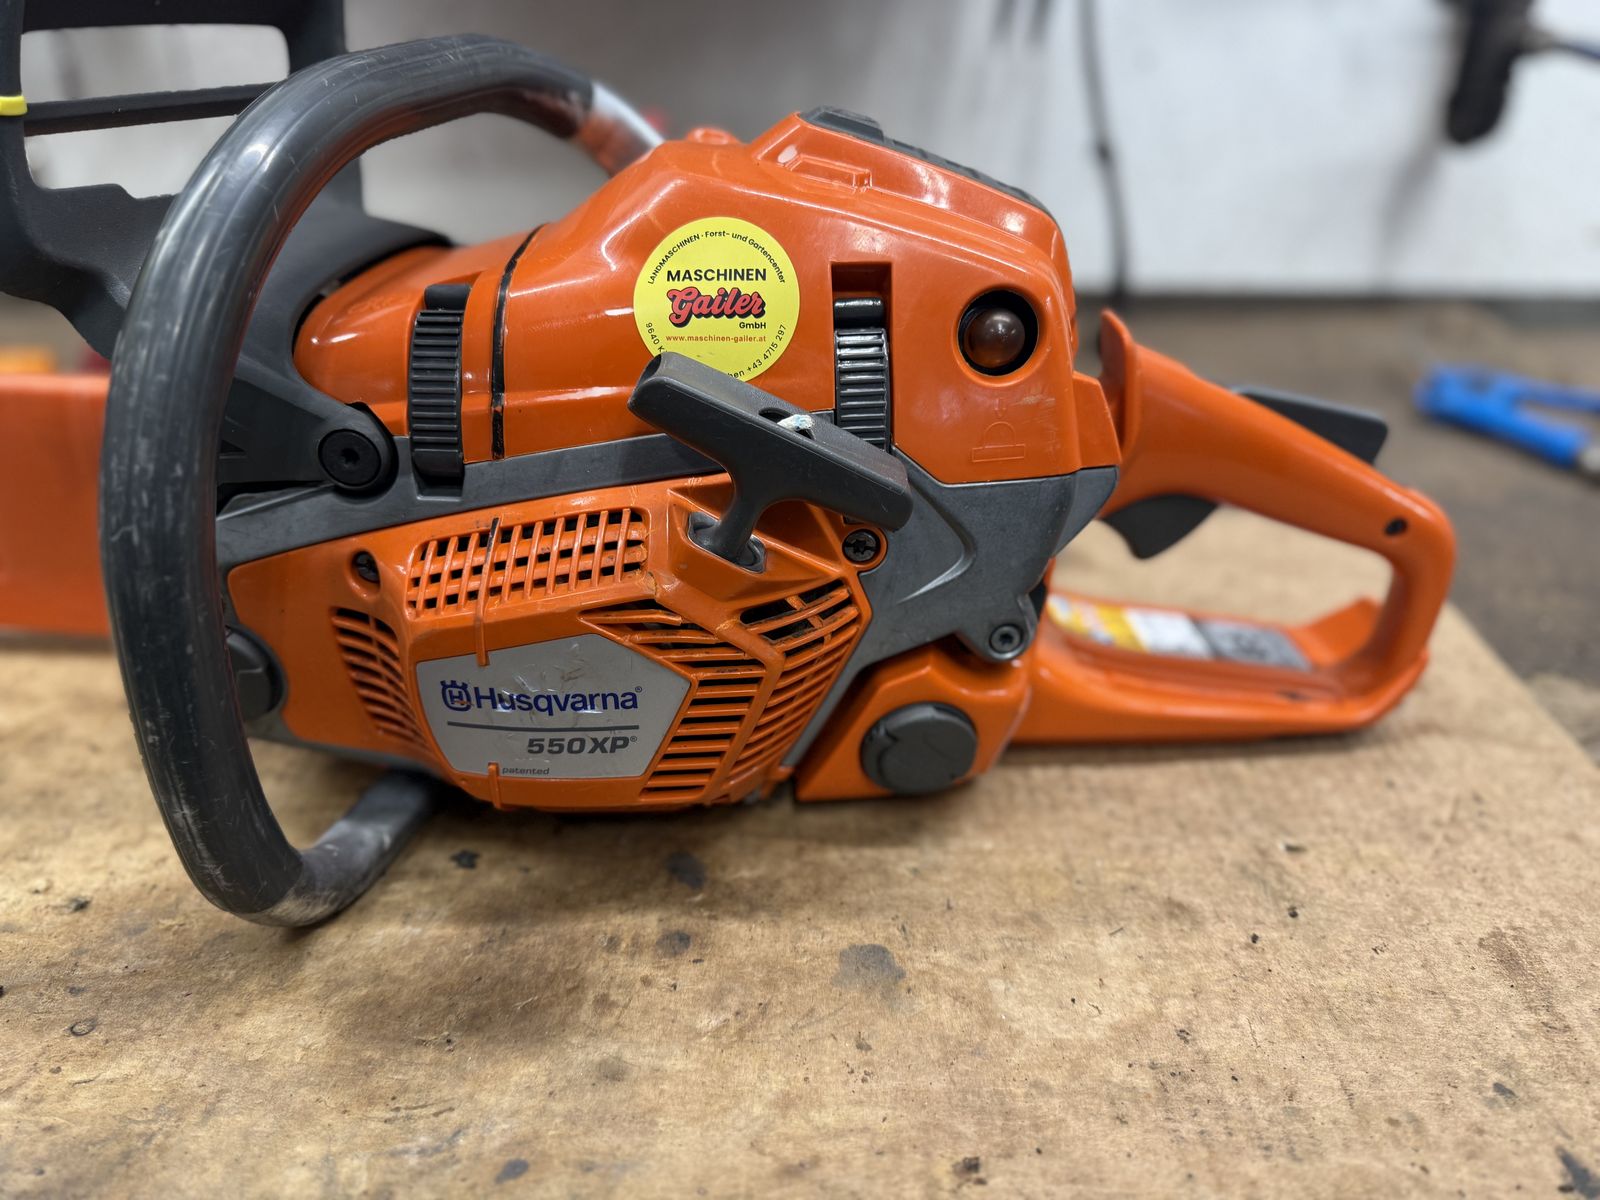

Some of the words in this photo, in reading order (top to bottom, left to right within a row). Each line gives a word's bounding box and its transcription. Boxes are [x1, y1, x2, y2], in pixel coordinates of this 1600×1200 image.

[648, 233, 700, 285] LANDMASCHINEN
[704, 230, 730, 238] Forst-
[731, 232, 748, 242] und
[748, 238, 786, 284] Gartencenter
[667, 268, 767, 282] MASCHINEN
[666, 286, 766, 328] Gailer
[739, 321, 767, 330] GmbH
[665, 334, 767, 343] www.maschinen-gailer.at
[645, 322, 660, 345] 9640
[746, 358, 763, 372] +43
[763, 341, 778, 361] 4715
[775, 324, 787, 341] 297
[502, 766, 550, 775] patented
